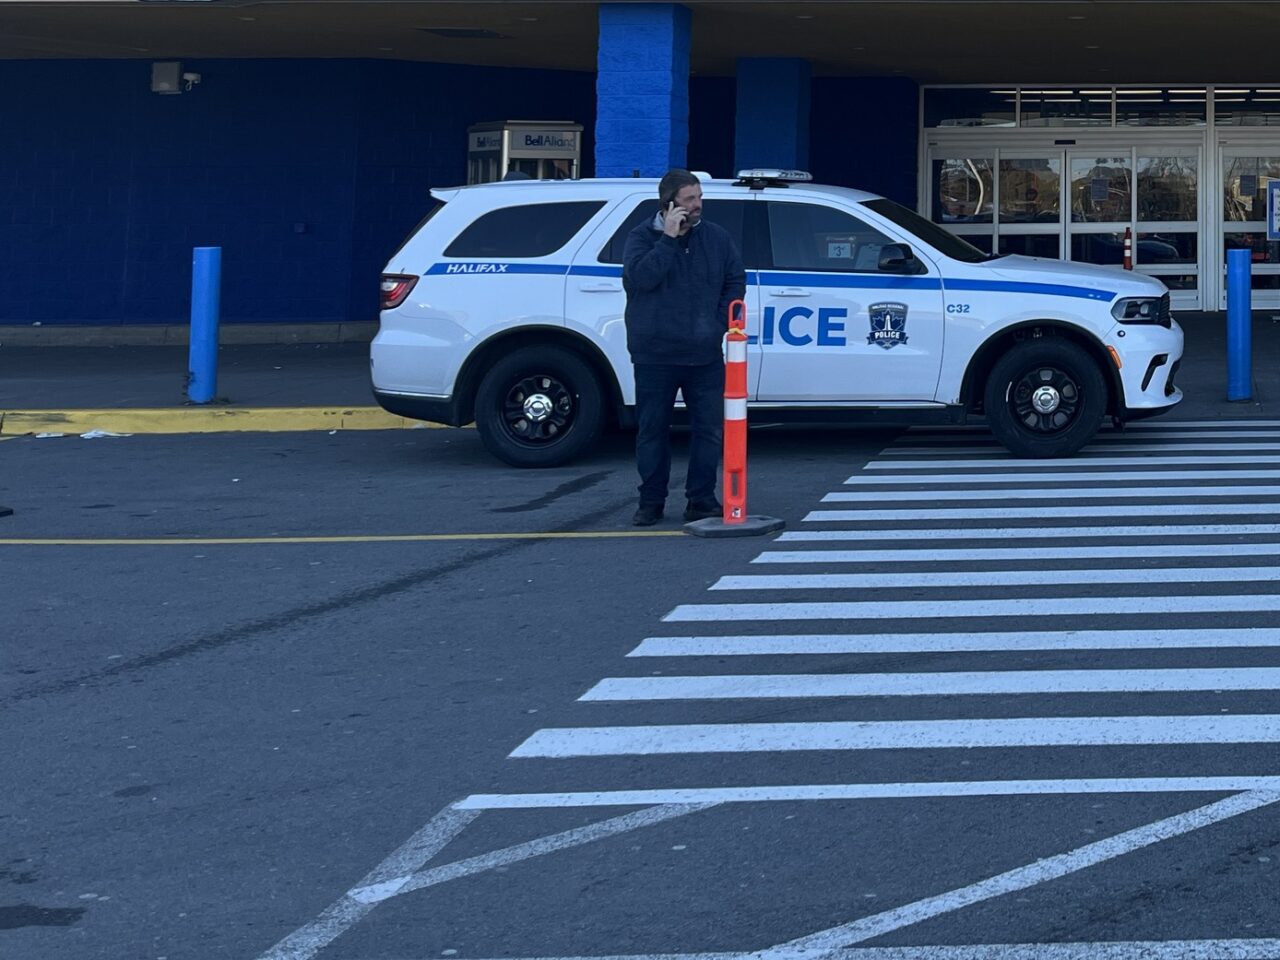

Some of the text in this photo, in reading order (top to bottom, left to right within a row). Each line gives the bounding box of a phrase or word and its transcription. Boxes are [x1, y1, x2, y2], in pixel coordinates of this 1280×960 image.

[446, 264, 509, 273] HALIFAX
[946, 304, 970, 313] C32
[874, 331, 900, 339] POLICE
